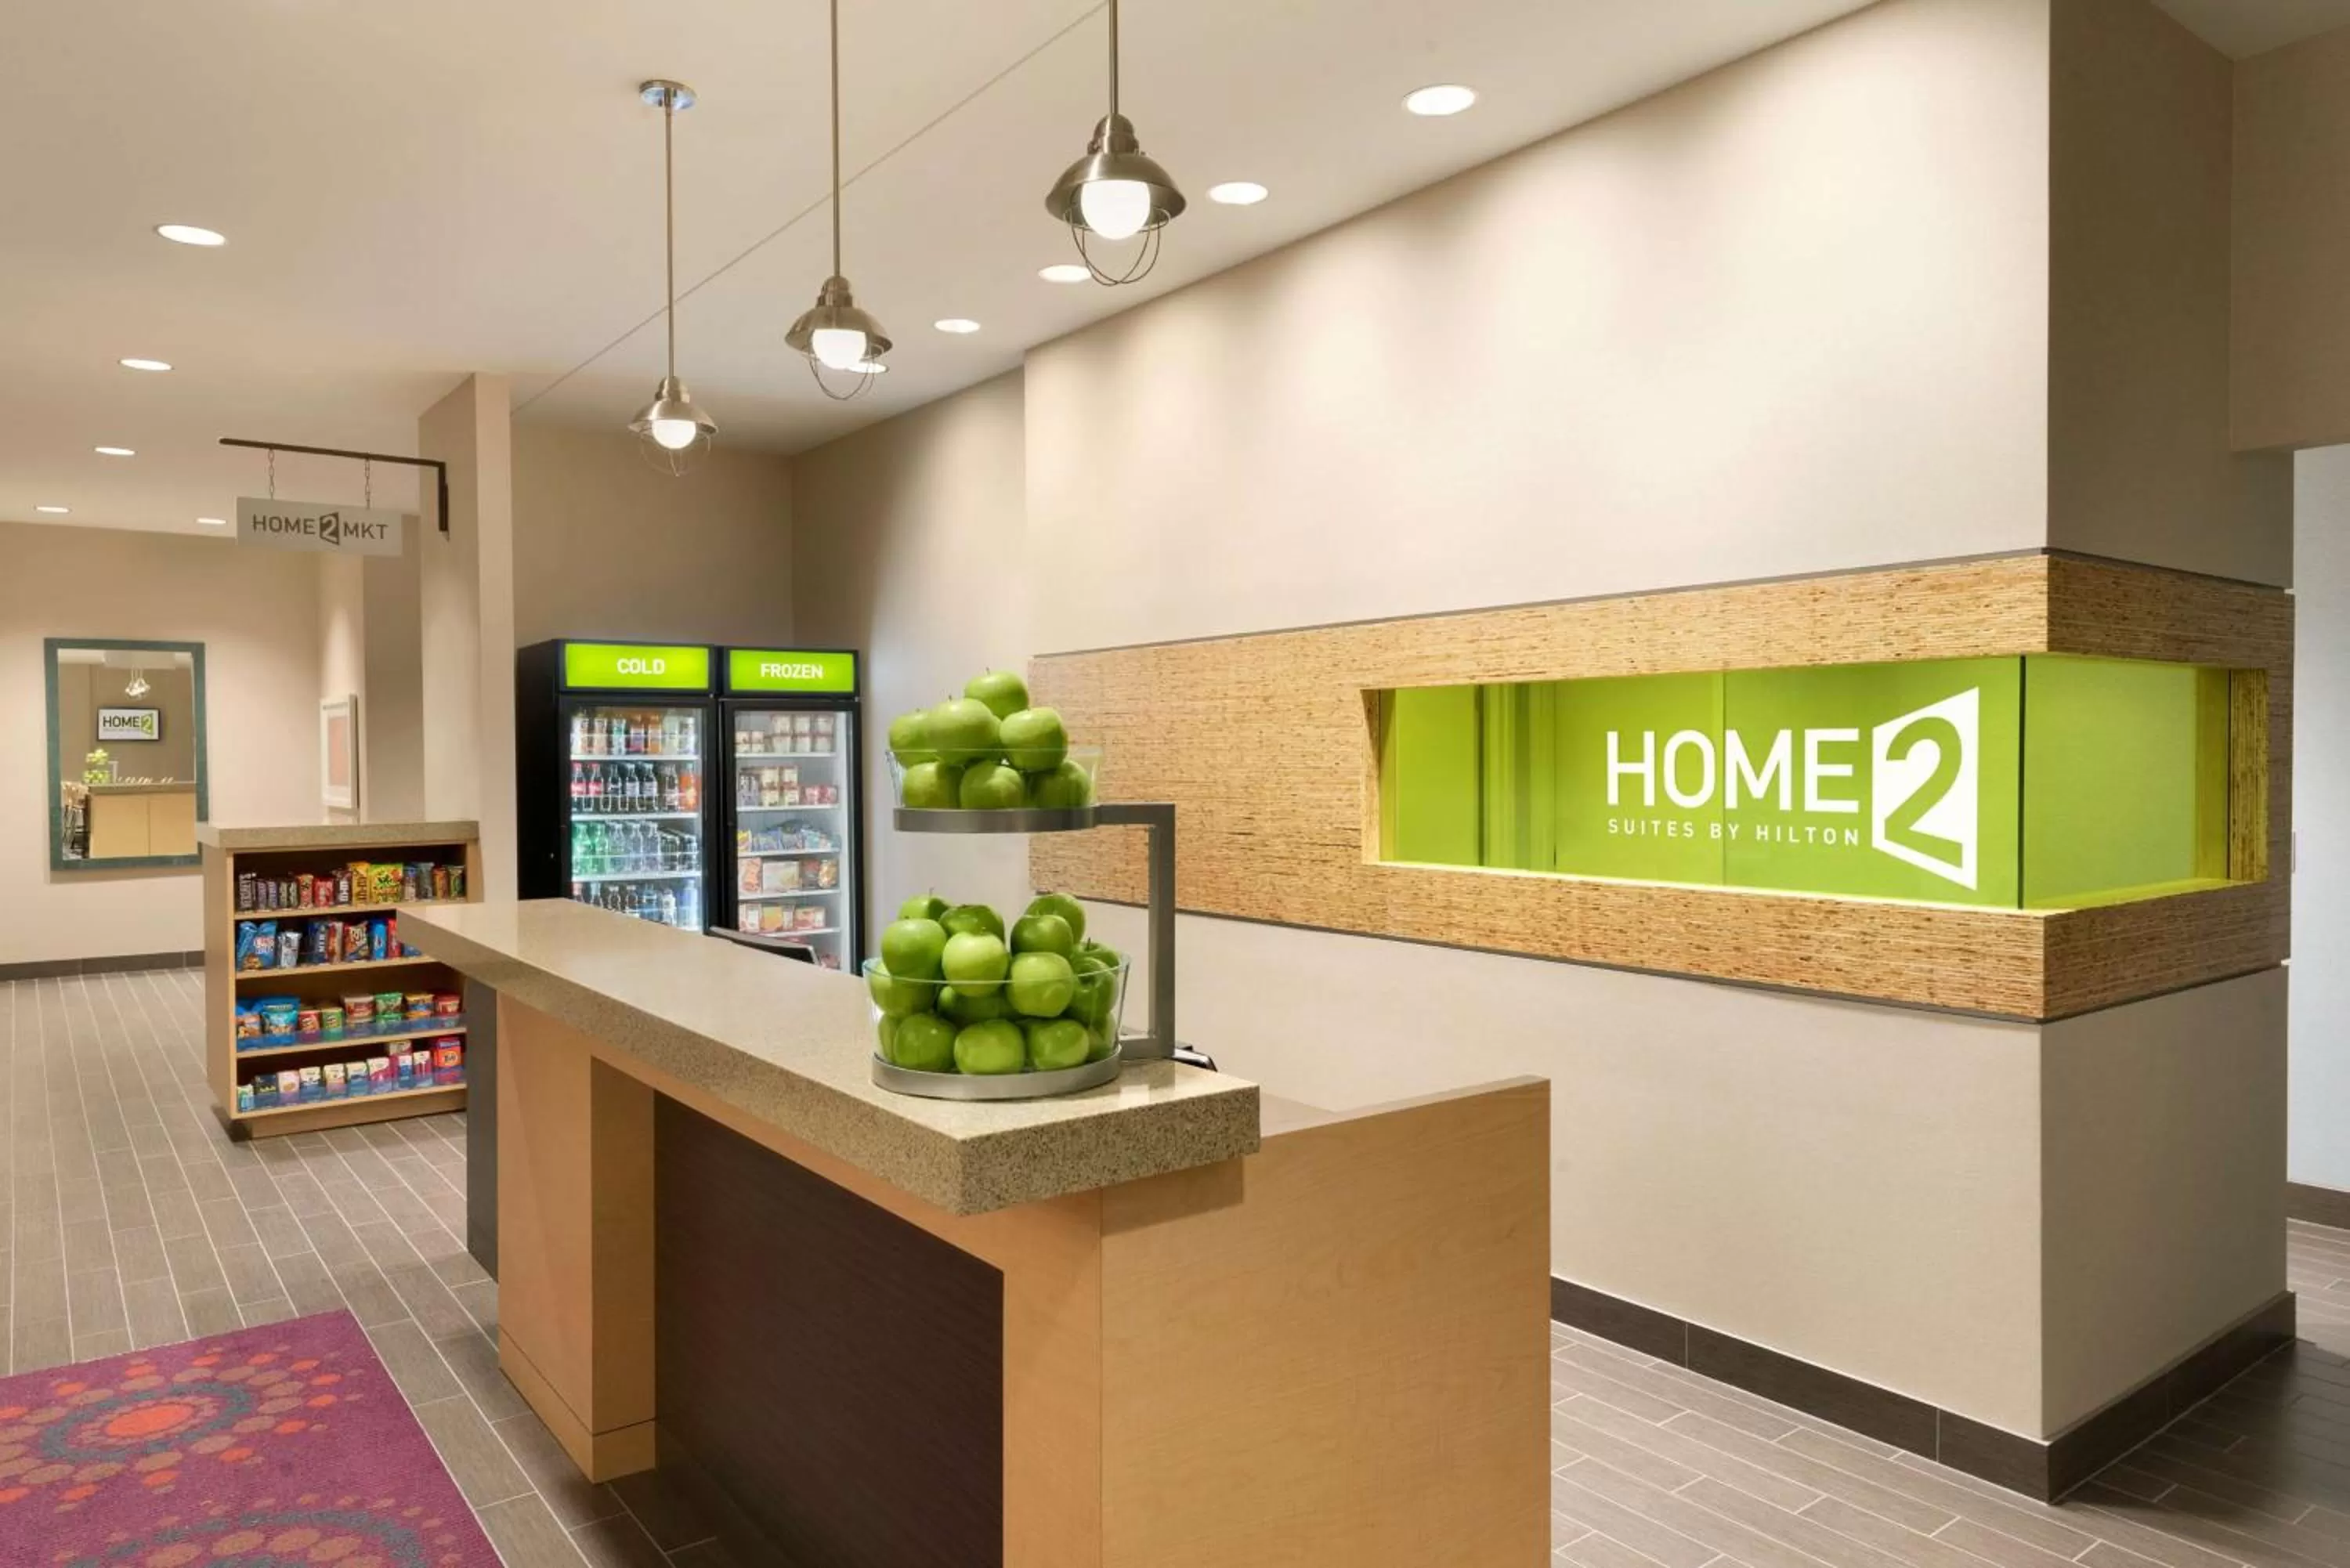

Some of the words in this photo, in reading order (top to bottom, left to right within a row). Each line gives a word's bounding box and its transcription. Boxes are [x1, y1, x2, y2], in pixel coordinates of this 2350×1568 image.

[616, 659, 665, 675] COLD
[760, 663, 824, 679] FROZEN
[1608, 818, 1694, 839] SUITES
[1710, 823, 1739, 841] BY
[1755, 824, 1860, 847] HILTON
